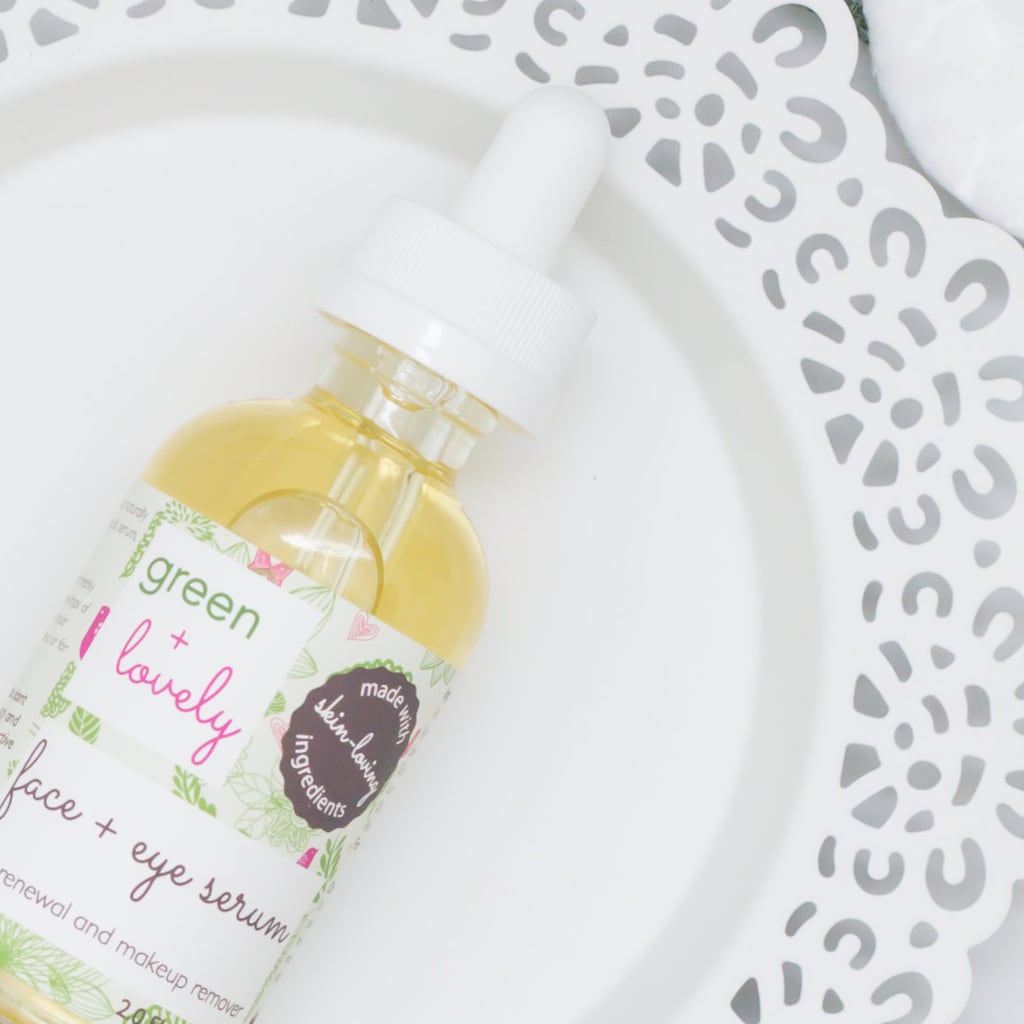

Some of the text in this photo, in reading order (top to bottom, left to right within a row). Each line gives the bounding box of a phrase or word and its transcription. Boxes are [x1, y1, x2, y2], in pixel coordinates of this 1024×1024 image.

[139, 557, 260, 639] green
[171, 630, 189, 650] +
[116, 618, 242, 766] lovely
[360, 682, 413, 745] made with
[291, 734, 347, 818] ingredients
[314, 694, 379, 807] skin-loving
[95, 818, 117, 838] +
[130, 842, 193, 902] eye
[199, 878, 289, 944] serum
[73, 913, 117, 946] and
[115, 939, 189, 991] makeup
[190, 982, 244, 1018] remover
